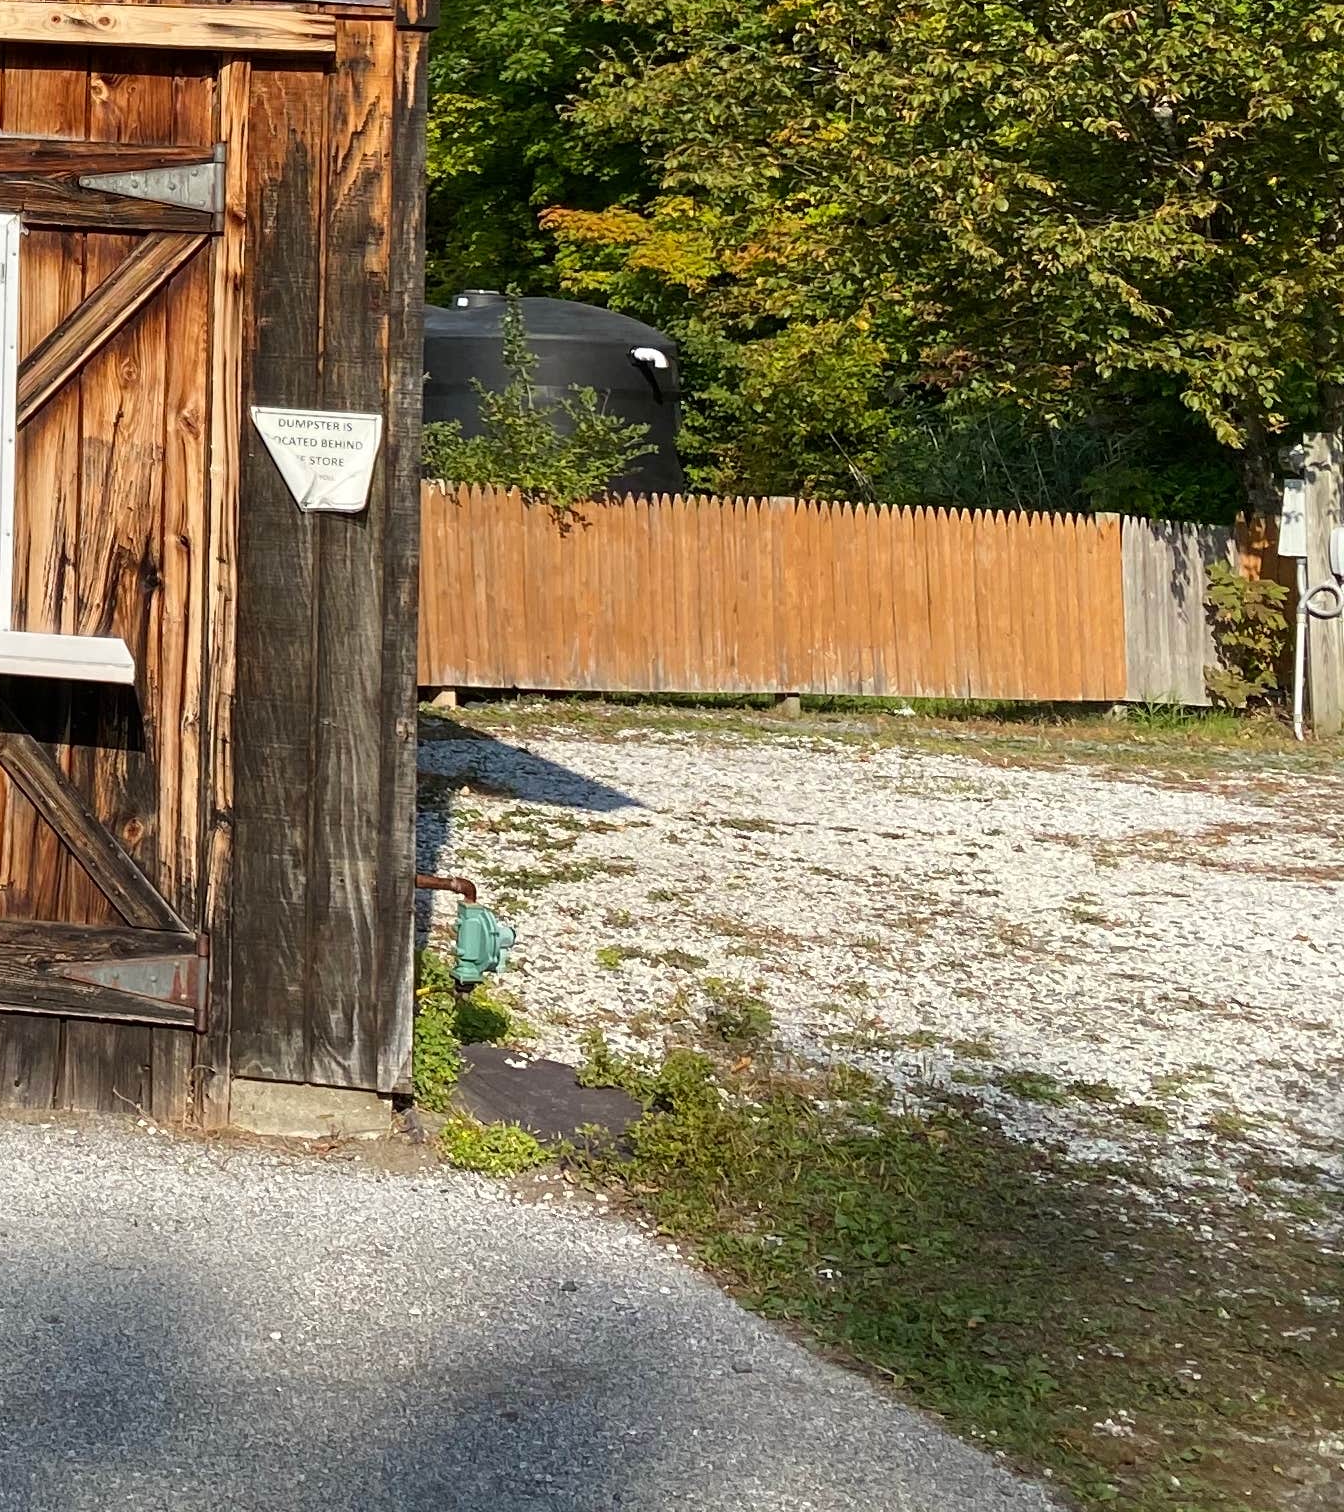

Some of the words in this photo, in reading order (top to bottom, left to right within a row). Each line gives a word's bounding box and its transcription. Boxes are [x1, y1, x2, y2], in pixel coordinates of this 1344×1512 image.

[278, 418, 340, 431] DUMPSTER
[343, 422, 353, 432] IS
[272, 435, 318, 447] OCATED
[321, 440, 363, 450] BEHIND
[309, 456, 344, 467] STORE
